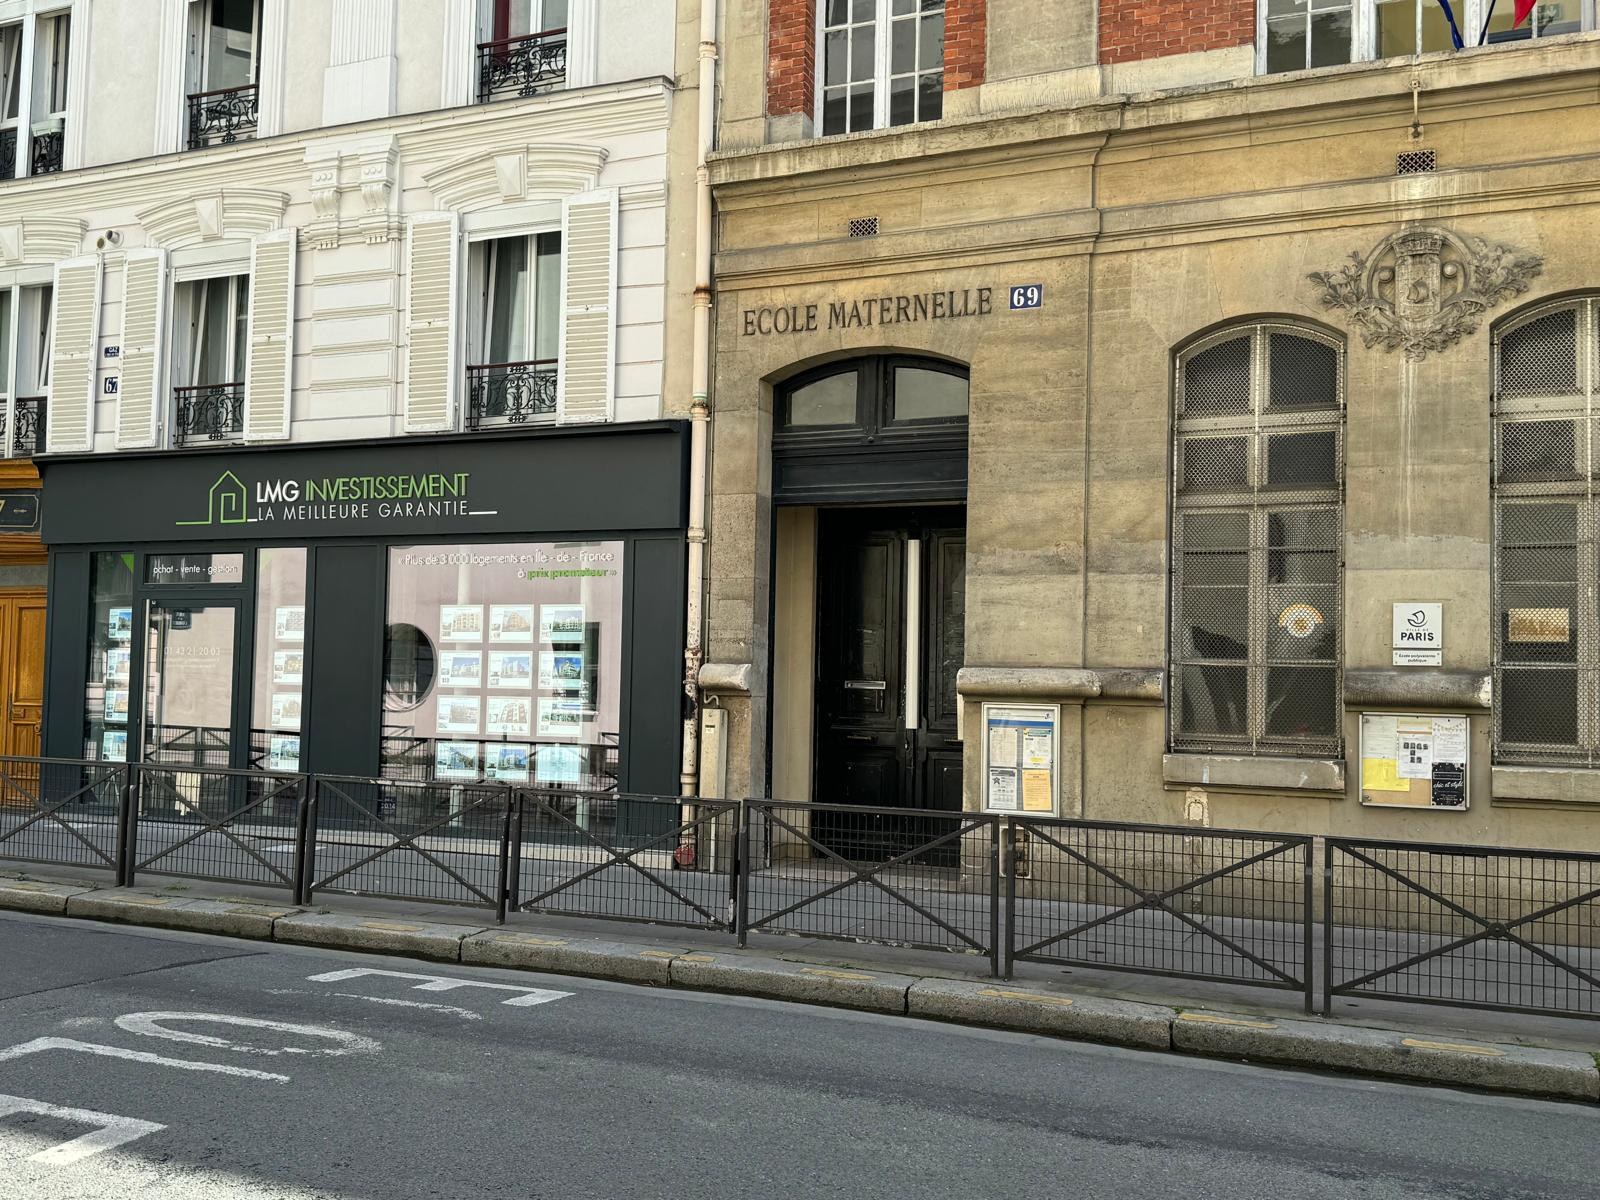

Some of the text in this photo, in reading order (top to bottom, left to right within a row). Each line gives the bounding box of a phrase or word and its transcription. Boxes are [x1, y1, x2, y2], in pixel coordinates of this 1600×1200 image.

[1012, 286, 1040, 308] 69
[742, 287, 992, 336] ECOLE MATERNELLE
[105, 378, 118, 392] 67
[256, 473, 470, 503] LMG INVESTISSEMENT
[258, 500, 468, 521] LA MEILLEURE GARANTIE
[557, 551, 571, 562] de
[580, 550, 615, 562] France
[180, 565, 200, 573] vente
[1400, 632, 1434, 641] PARIS
